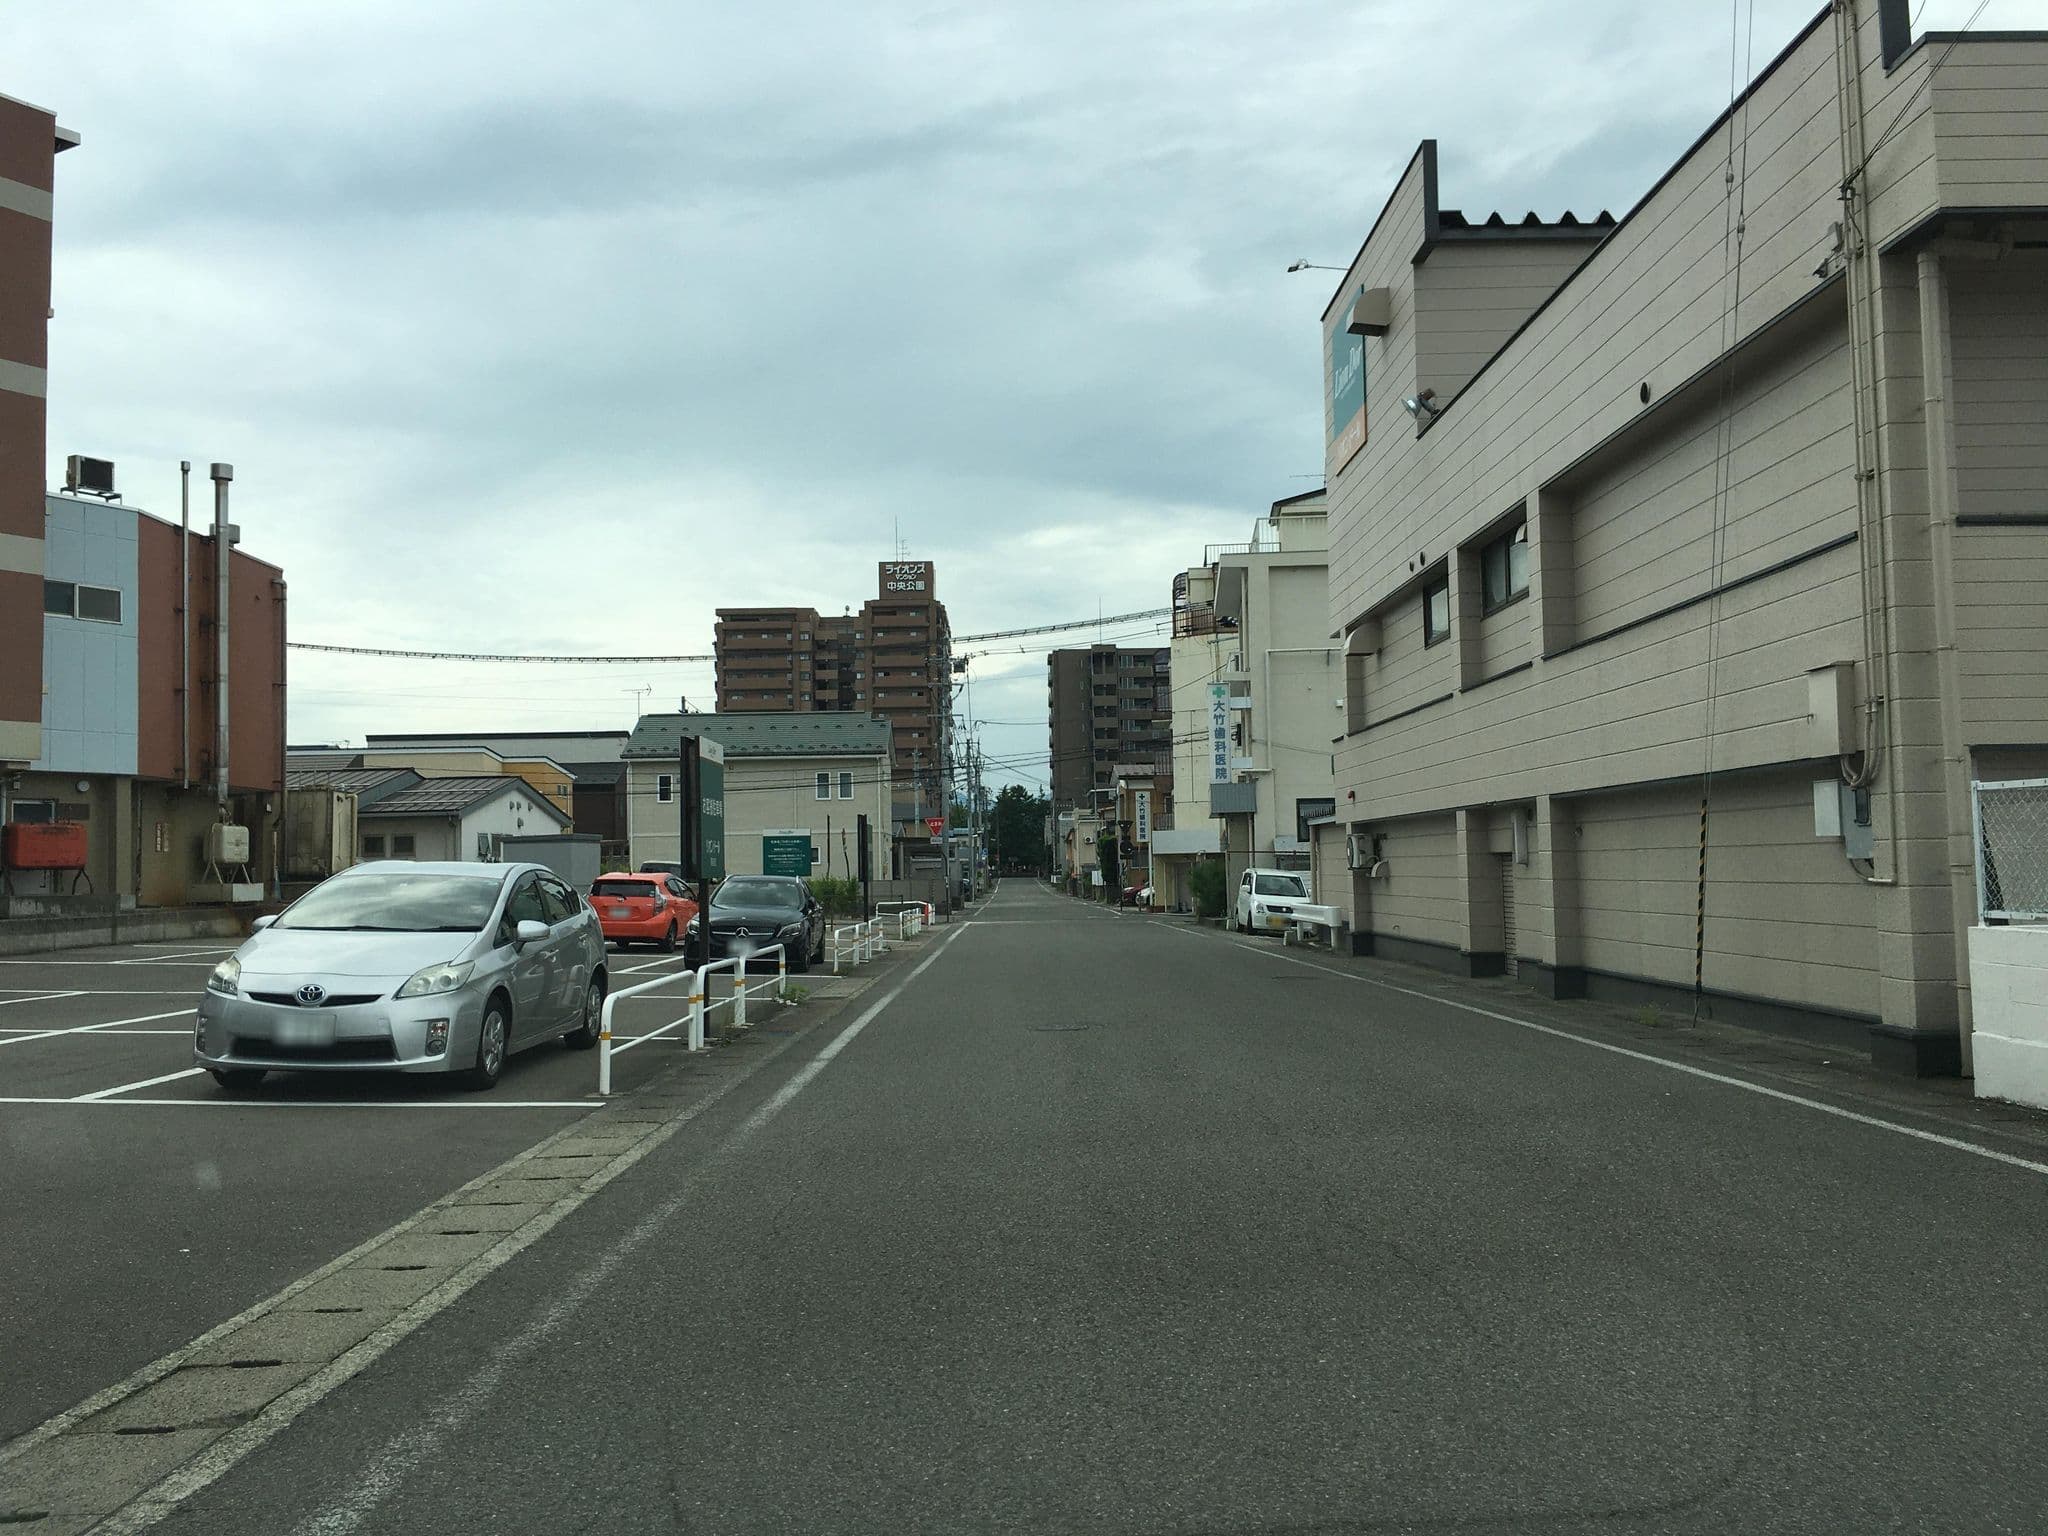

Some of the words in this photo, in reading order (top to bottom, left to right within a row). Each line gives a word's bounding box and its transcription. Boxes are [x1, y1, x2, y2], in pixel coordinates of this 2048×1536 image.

[885, 563, 926, 575] ライオンズ
[887, 580, 925, 591] 中央公園
[1213, 700, 1227, 780] 大竹歯科医院
